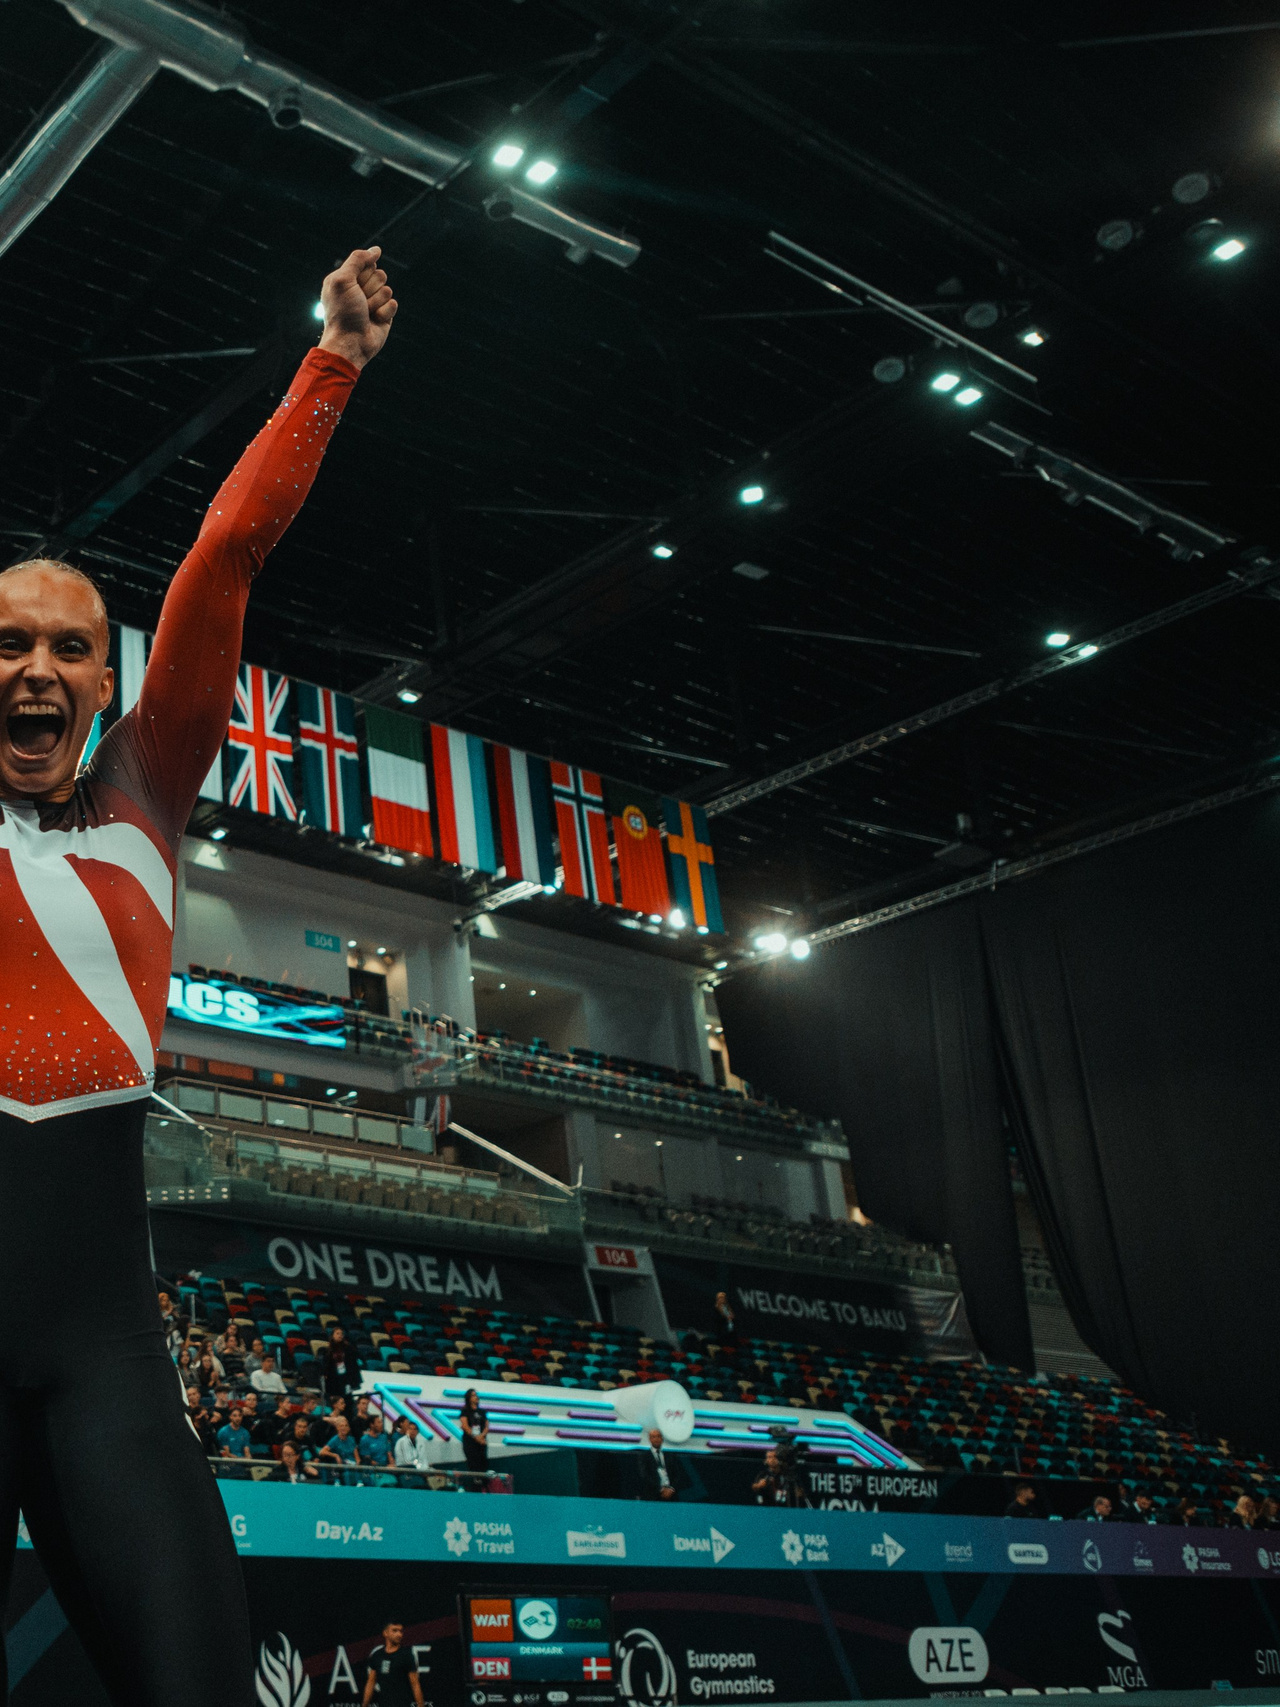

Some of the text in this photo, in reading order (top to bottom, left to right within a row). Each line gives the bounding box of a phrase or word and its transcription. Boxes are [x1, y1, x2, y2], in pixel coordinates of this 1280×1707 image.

[314, 932, 334, 949] 304
[267, 1236, 503, 1301] ONE DREAM
[605, 1249, 628, 1265] 104
[736, 1286, 907, 1332] WELCOME TO BAKU
[809, 1472, 836, 1493] THE
[867, 1475, 938, 1498] EUROPEAN
[230, 1514, 247, 1537] G
[315, 1520, 384, 1544] Day.Az
[473, 1522, 513, 1537] PASHA
[475, 1539, 515, 1555] Travel
[473, 1614, 511, 1628] WAIT
[520, 1645, 564, 1656] DENMARK
[686, 1649, 757, 1673] European
[924, 1638, 976, 1673] AZE
[473, 1660, 510, 1677] DEN
[1106, 1665, 1149, 1689] MGA
[689, 1674, 776, 1700] Gymnastics
